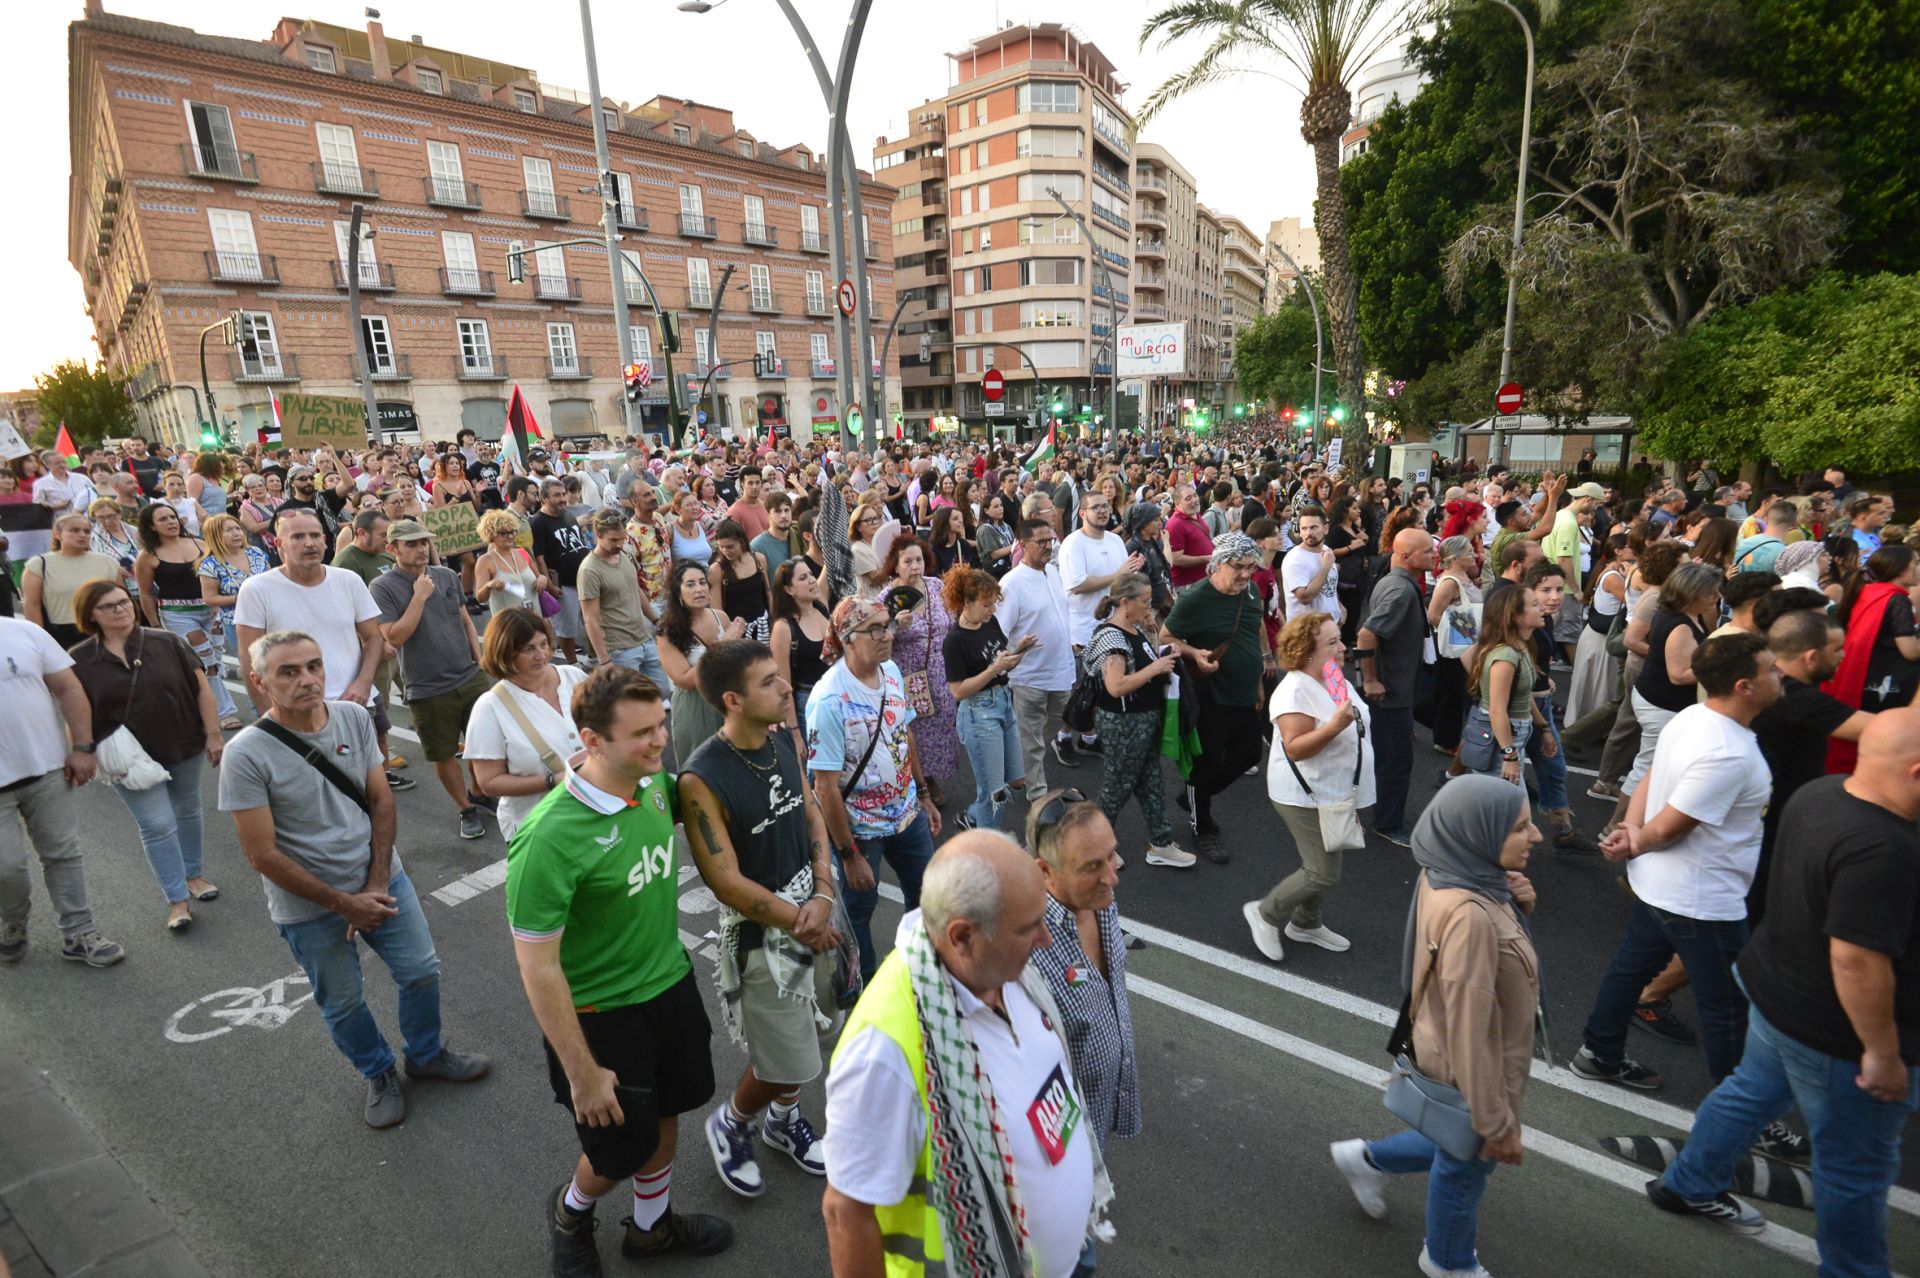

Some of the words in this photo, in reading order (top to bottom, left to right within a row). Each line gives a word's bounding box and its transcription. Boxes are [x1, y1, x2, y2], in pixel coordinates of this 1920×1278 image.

[297, 415, 359, 437] LIBRE
[627, 834, 675, 898] sky
[1035, 1078, 1067, 1139] ALTO
